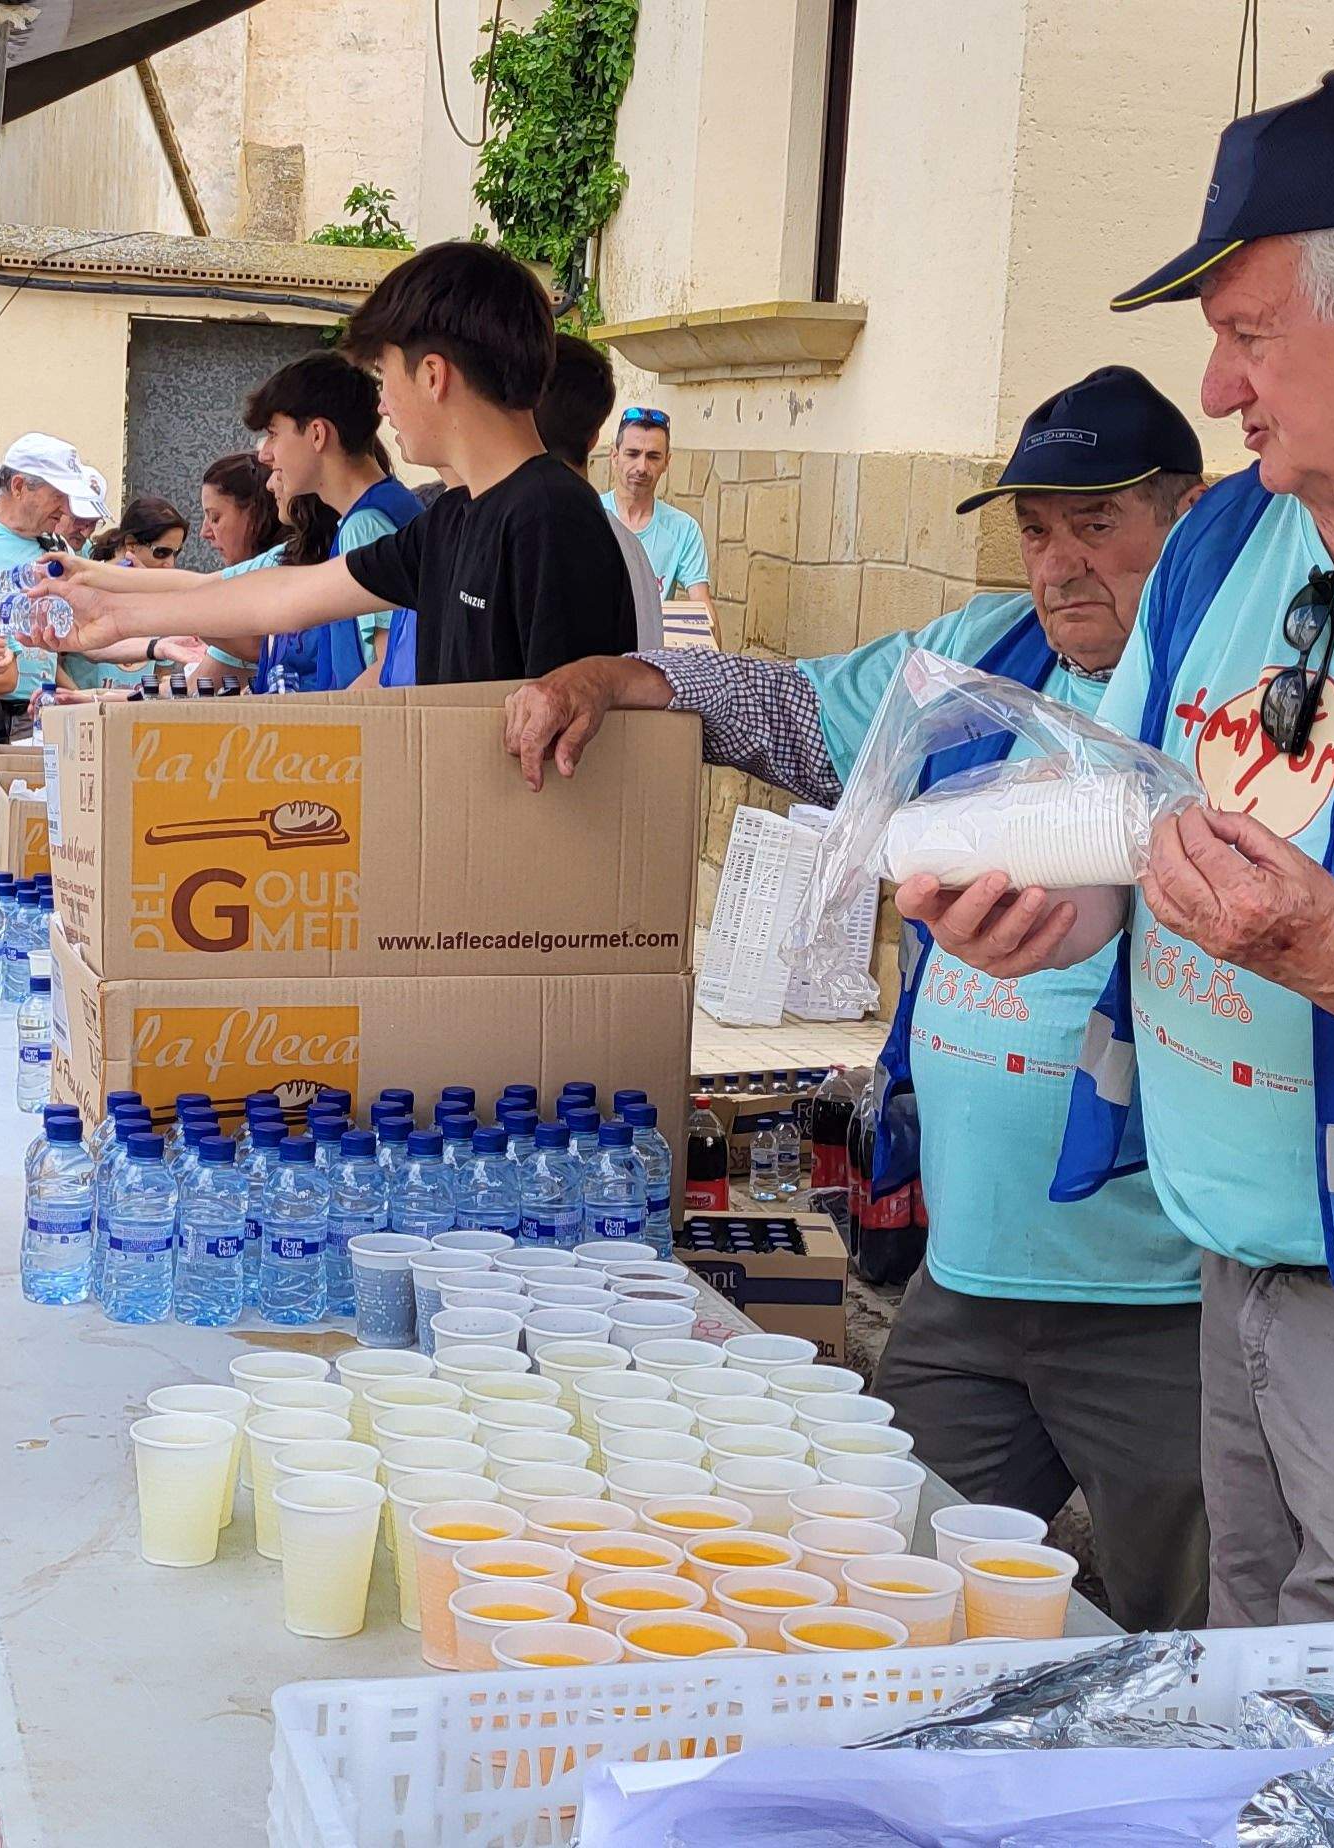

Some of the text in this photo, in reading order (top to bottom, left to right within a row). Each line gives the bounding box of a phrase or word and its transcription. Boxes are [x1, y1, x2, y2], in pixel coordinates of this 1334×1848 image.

[132, 724, 363, 801] la fleca
[131, 872, 166, 951] DEL
[252, 911, 363, 952] MET
[378, 931, 679, 953] www.laflecadelgourmet.com
[132, 1007, 361, 1083] la fleca
[1255, 1068, 1314, 1087] Ayuntamiento
[604, 1218, 625, 1229] Font
[604, 1228, 626, 1237] Vella
[218, 1238, 237, 1249] Font
[281, 1239, 303, 1249] Font
[218, 1247, 237, 1257] Vella
[280, 1247, 303, 1258] Vella
